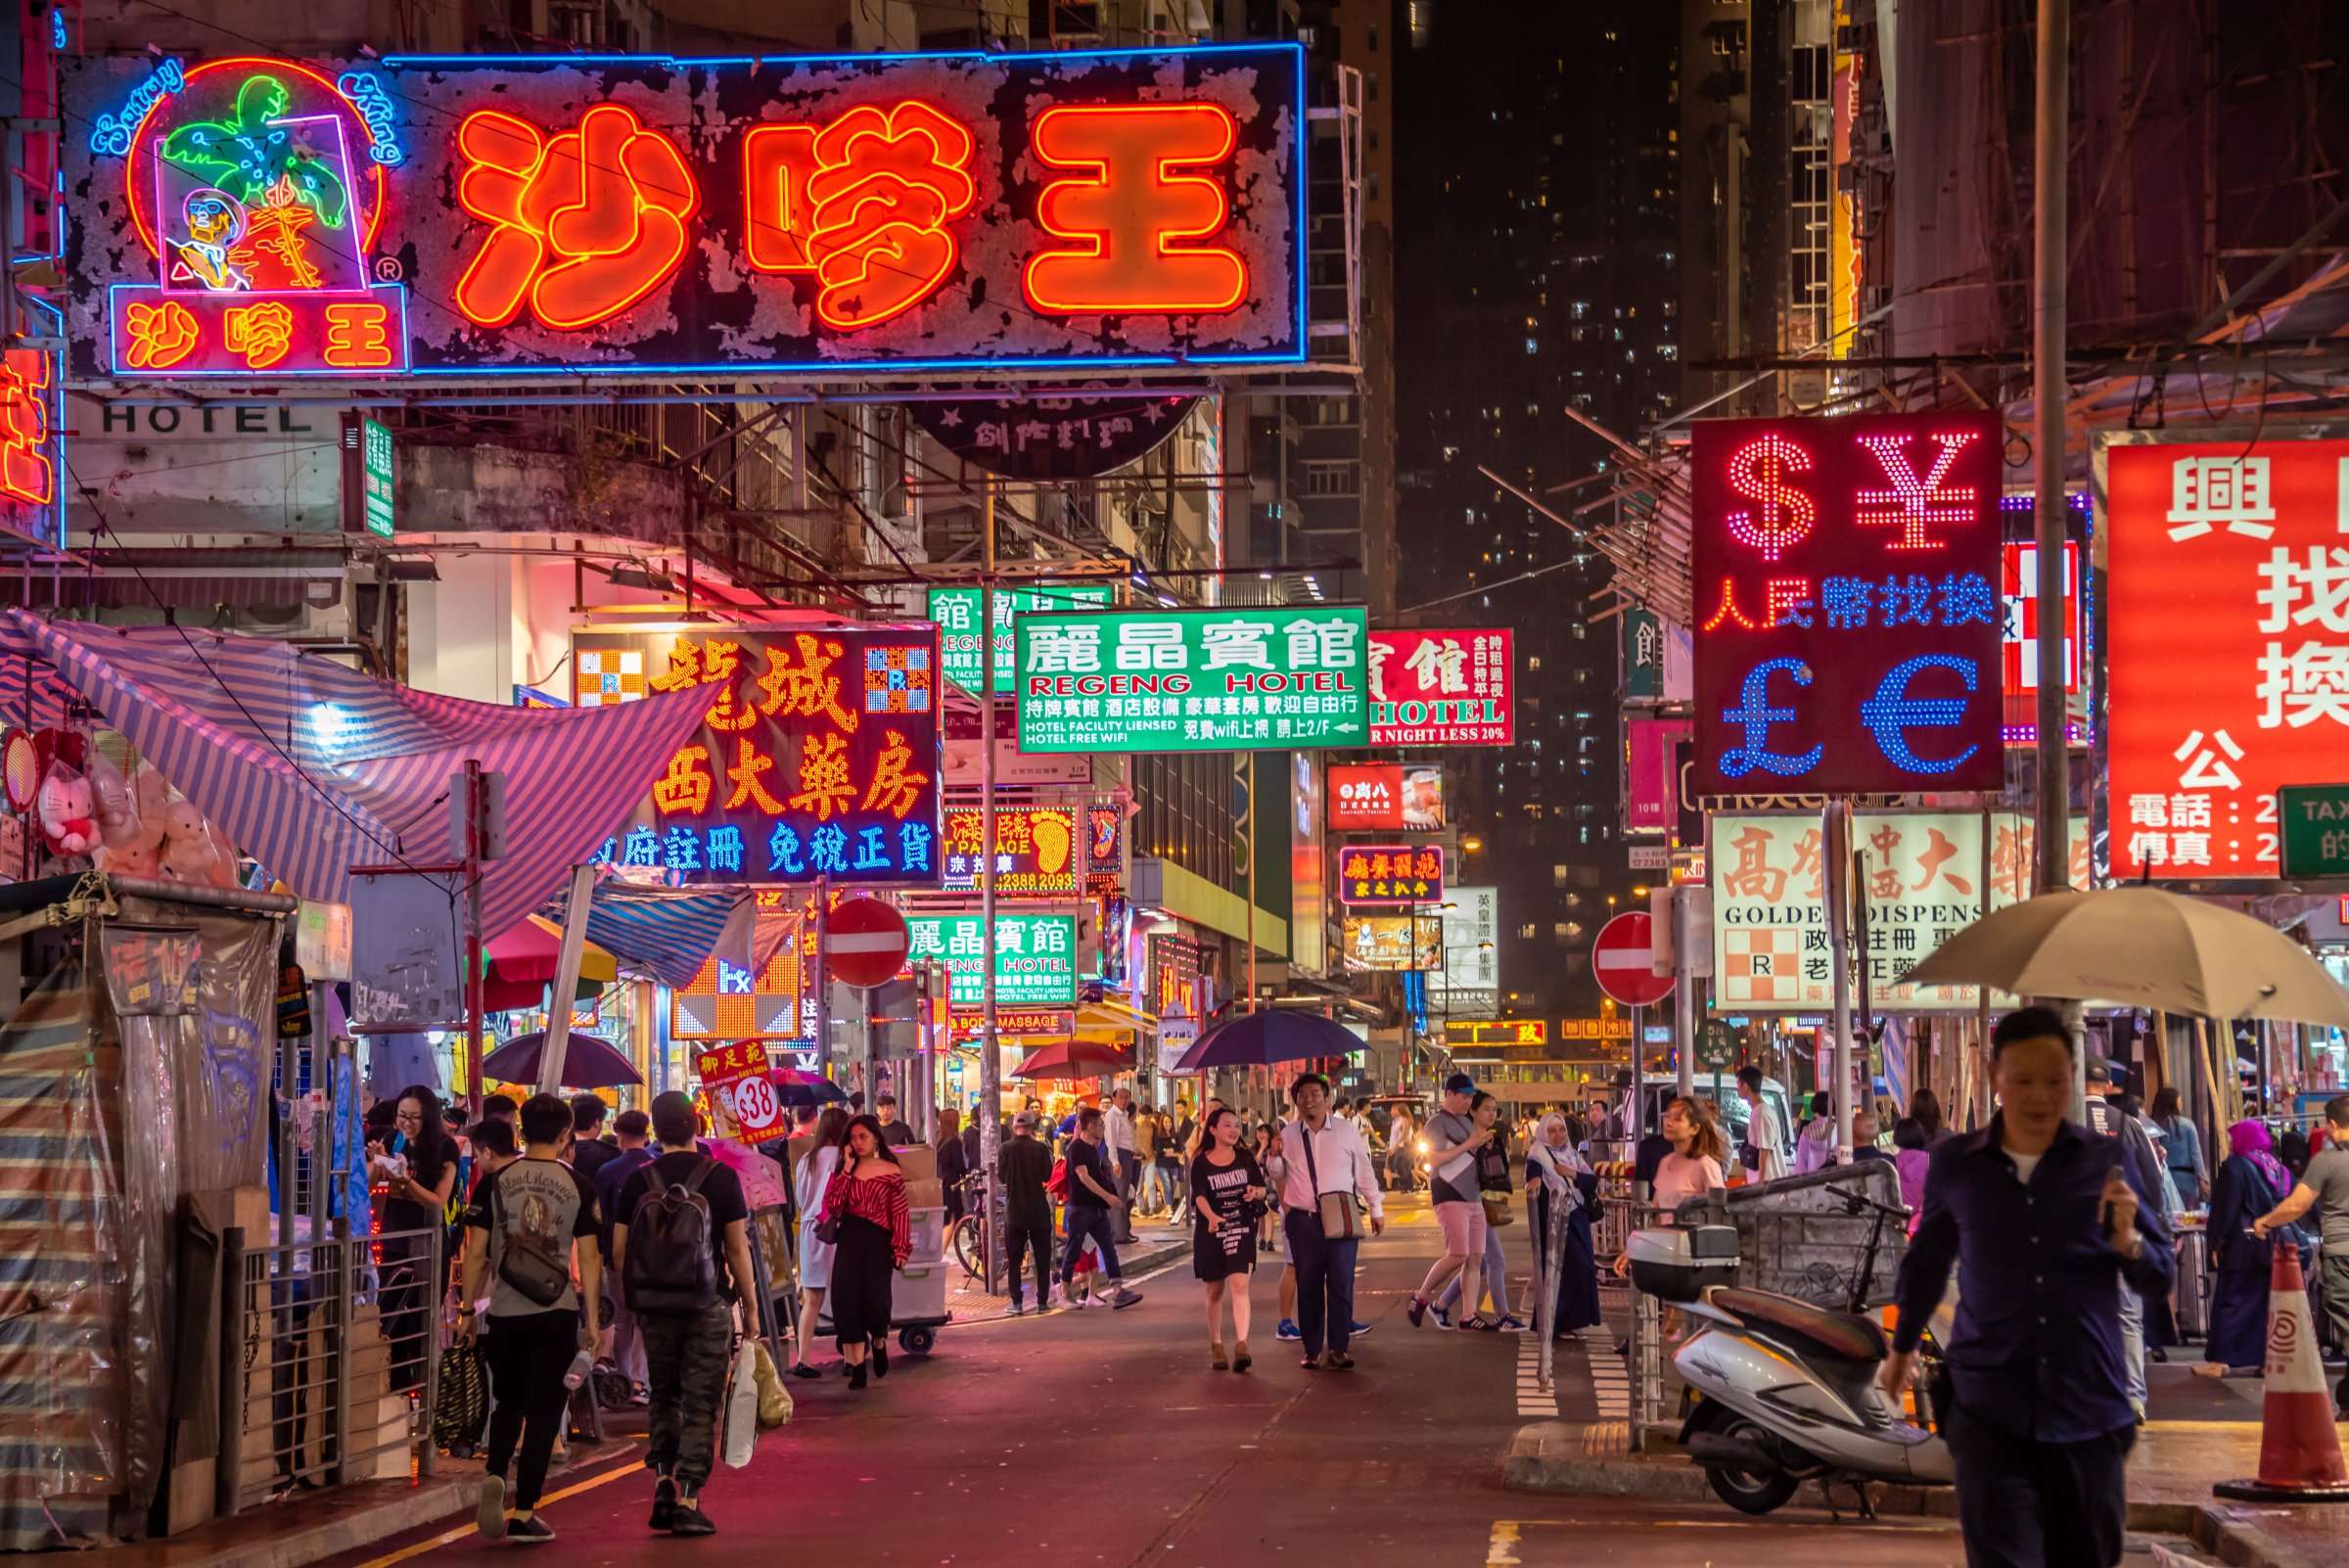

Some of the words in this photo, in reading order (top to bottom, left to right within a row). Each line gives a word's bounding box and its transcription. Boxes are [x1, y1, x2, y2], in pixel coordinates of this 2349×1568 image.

[456, 100, 1251, 331] 沙嗲王
[126, 301, 392, 368] 沙嗲王
[103, 405, 311, 433] HOTEL
[1703, 573, 1995, 631] 人民幣找換
[1025, 618, 1359, 673] 麗晶賓館
[1029, 673, 1192, 697] REGENG
[1225, 671, 1356, 694] HOTEL
[1026, 722, 1066, 732] HOTEL
[1069, 721, 1122, 732] FACILITY
[1126, 720, 1176, 731] LIENSED
[1370, 700, 1504, 726] HOTEL
[1026, 733, 1066, 744] HOTEL
[1069, 733, 1098, 744] FREE
[1101, 732, 1128, 743] WIFI
[1385, 728, 1436, 742] NIGHT
[1440, 727, 1478, 741] LESS
[1482, 727, 1505, 740] 20%
[653, 731, 929, 821] 西大藥房
[768, 821, 932, 872] 免稅正貨
[958, 840, 1031, 854] PAACE
[1725, 905, 1821, 926] GOLDE
[908, 918, 1069, 955] 麗晶賓館
[1003, 956, 1072, 972] HOTEL
[998, 1016, 1059, 1028] MASSAGE
[740, 1079, 772, 1122] $38
